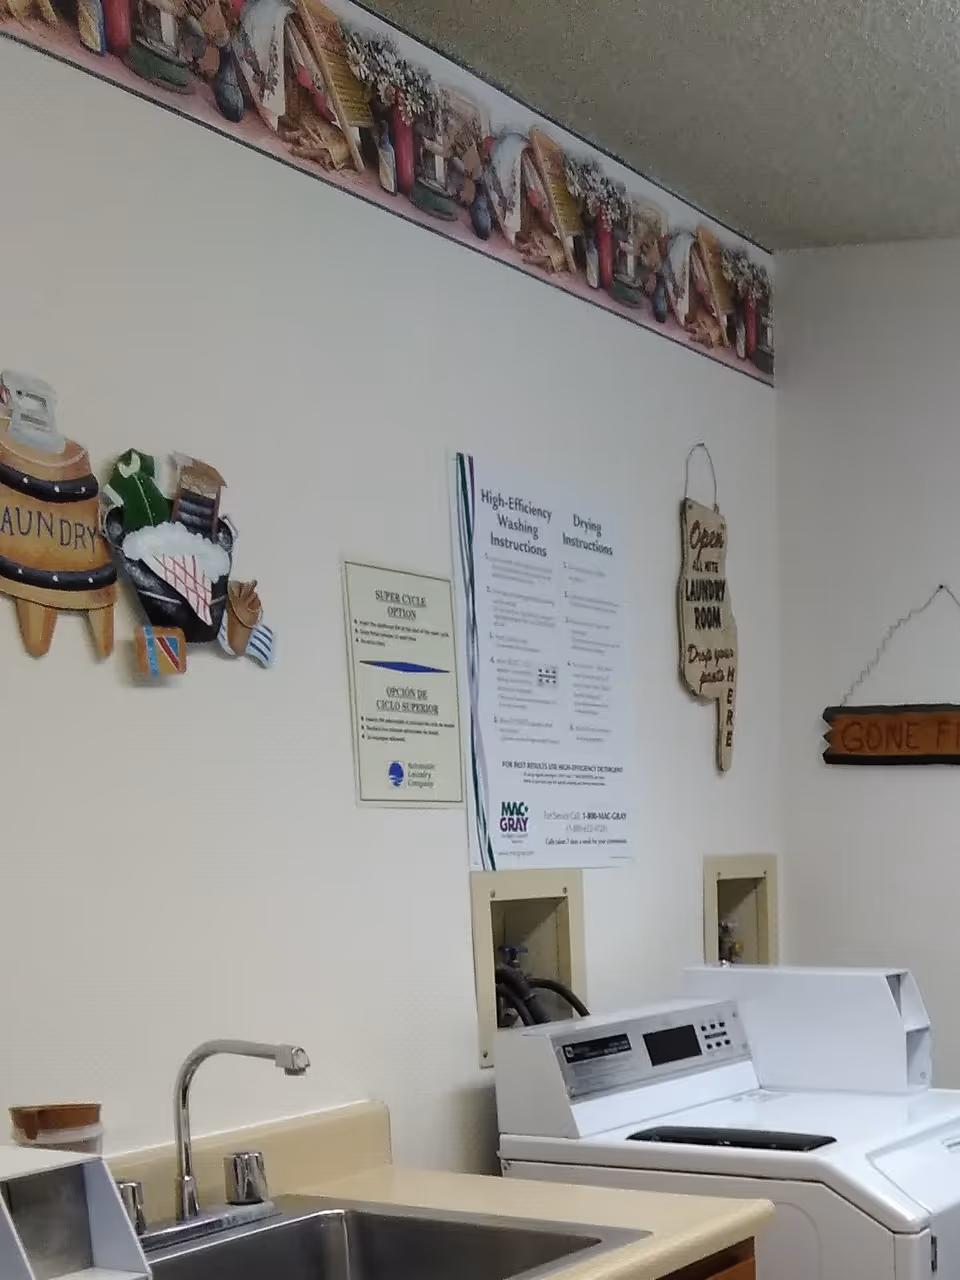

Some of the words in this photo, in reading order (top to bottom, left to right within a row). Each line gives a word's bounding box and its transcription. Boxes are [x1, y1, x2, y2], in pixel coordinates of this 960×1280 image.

[481, 489, 552, 524] High-Efficiency
[497, 513, 539, 540] Washing
[573, 513, 602, 538] Drying
[490, 531, 547, 557] Instructions
[562, 532, 613, 556] Instructions
[690, 520, 724, 560] Open
[375, 589, 401, 603] SUPER
[402, 592, 427, 608] CYCLE
[686, 579, 726, 602] LAUNDRY
[387, 606, 417, 620] OPTION
[694, 606, 721, 630] ROOM
[688, 644, 712, 668] Drop
[714, 648, 734, 667] your
[699, 668, 725, 694] pants
[417, 689, 428, 701] DE
[376, 699, 401, 713] CICLO
[402, 702, 439, 716] SUPERIOR
[841, 720, 920, 752] GONE
[502, 760, 513, 768] FOR
[499, 817, 528, 833] GRAY
